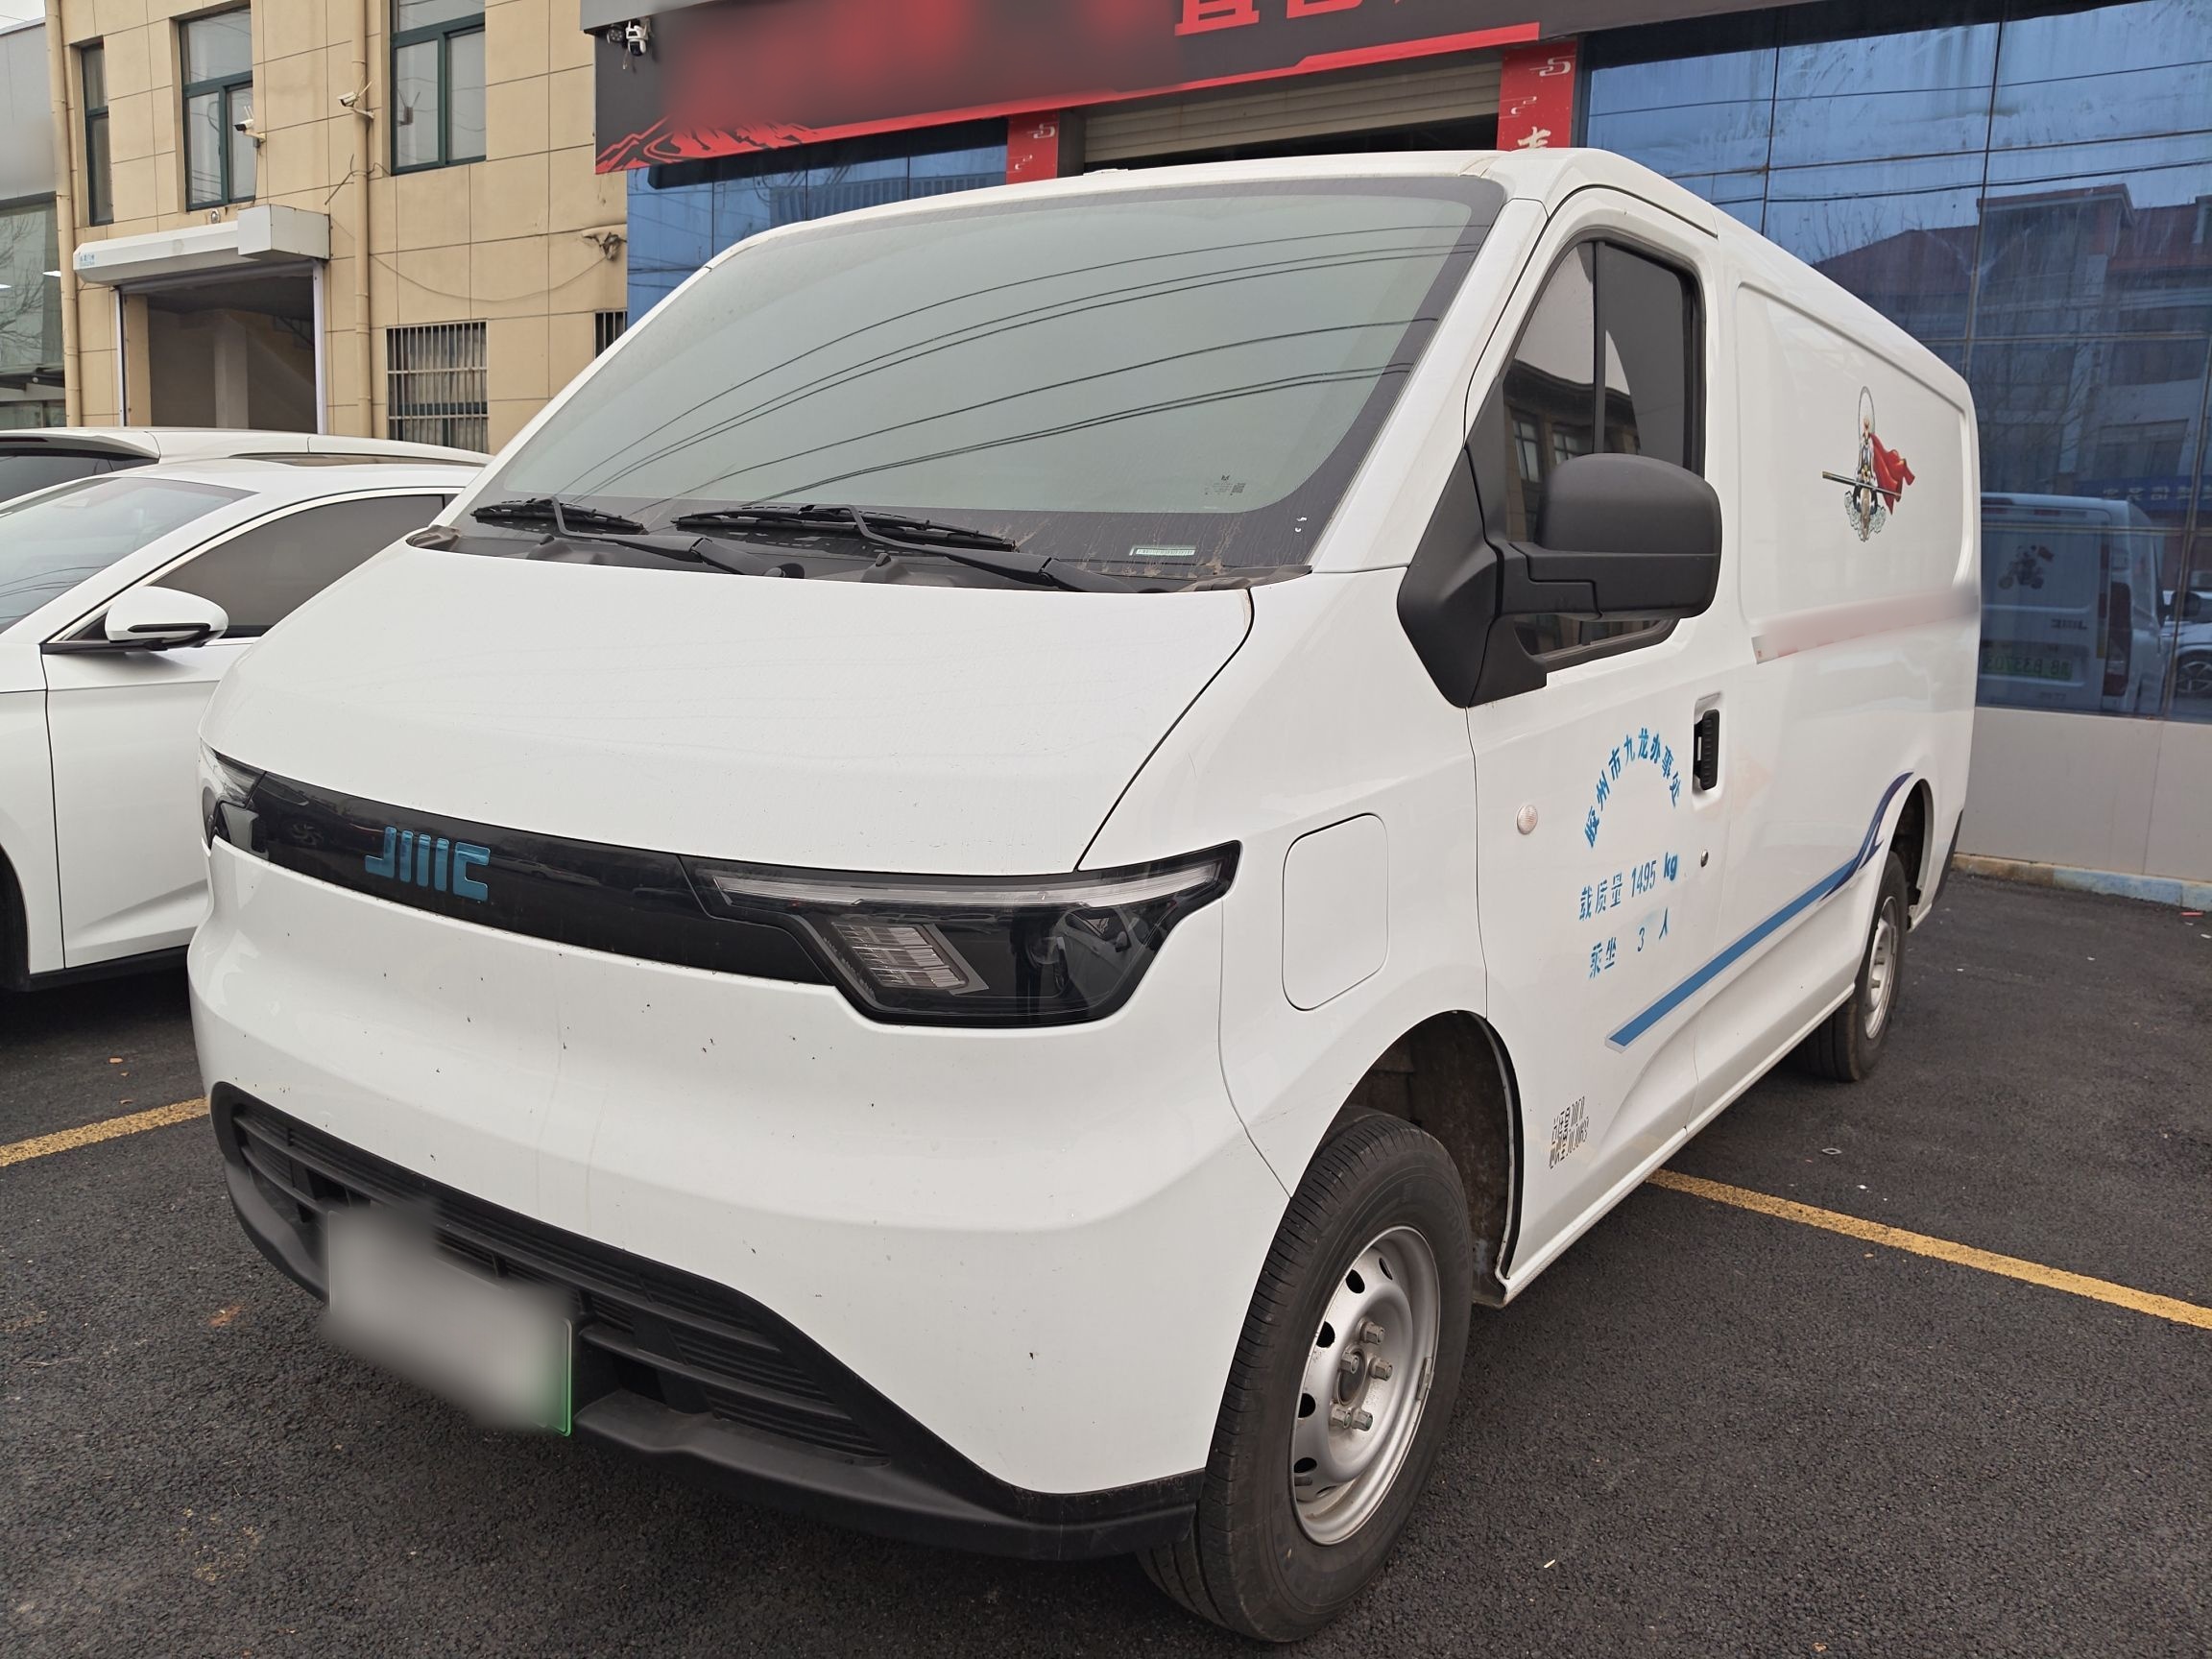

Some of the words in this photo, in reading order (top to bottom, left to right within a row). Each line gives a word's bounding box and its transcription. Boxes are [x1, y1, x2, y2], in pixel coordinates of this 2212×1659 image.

[1584, 727, 1681, 848] 胶州市九龙办事处
[364, 826, 491, 902] JMC
[1579, 872, 1623, 922] 载质量
[1631, 860, 1657, 898] 1495
[1663, 852, 1678, 881] kg
[1589, 936, 1617, 979] 乘坐
[1637, 927, 1645, 952] 3
[1658, 907, 1669, 940] 人
